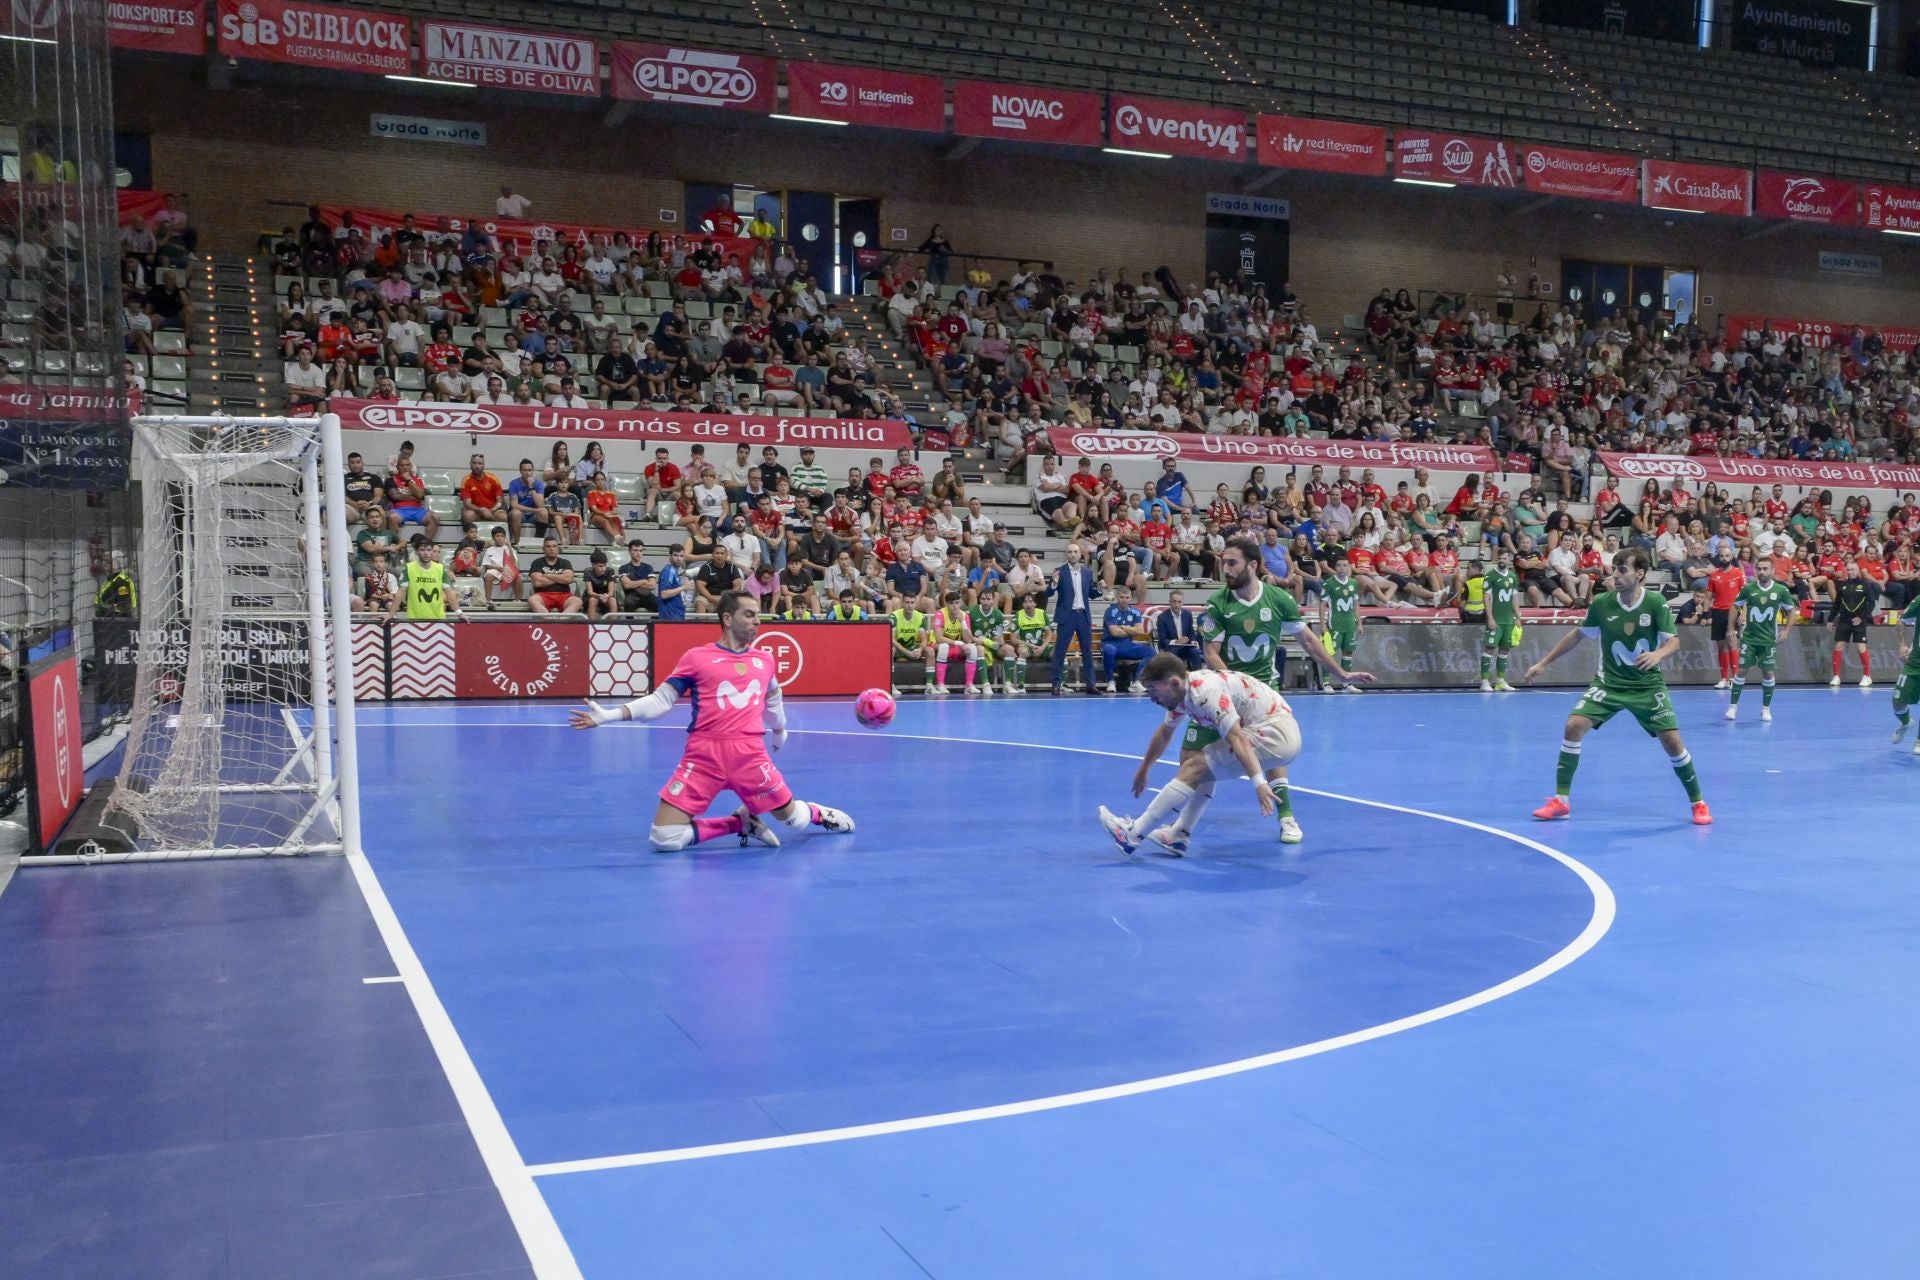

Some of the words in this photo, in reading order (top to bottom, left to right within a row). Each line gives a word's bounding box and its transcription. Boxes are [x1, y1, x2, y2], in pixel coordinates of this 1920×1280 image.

[282, 8, 407, 50] SEIBLOCK
[1743, 3, 1852, 35] Ayuntamiento
[440, 28, 581, 72] MANZANO
[1757, 34, 1777, 53] de
[1781, 38, 1835, 62] Murcia
[426, 62, 506, 84] ACEITES
[511, 71, 536, 86] DE
[541, 74, 595, 92] OLIVA
[858, 88, 914, 105] karkemis
[992, 95, 1063, 120] NOVAC
[376, 120, 428, 135] Grada
[1283, 133, 1303, 152] itv
[1306, 139, 1324, 149] red
[1326, 139, 1374, 154] itevemur
[1443, 150, 1473, 166] SALUD
[1546, 158, 1584, 172] Aditivos
[1586, 162, 1600, 173] del
[1602, 163, 1635, 177] Sureste
[1674, 177, 1742, 200] CaixaBank
[1210, 197, 1248, 211] Grada
[1254, 201, 1286, 214] Norte
[1885, 214, 1898, 226] de
[533, 416, 604, 436] Uno
[618, 417, 681, 435] más
[693, 419, 729, 435] de
[741, 420, 765, 437] la
[776, 420, 884, 442] familia
[1202, 436, 1258, 454] Uno
[1268, 442, 1318, 457] más
[1326, 444, 1354, 459] de
[1361, 445, 1382, 460] la
[1391, 443, 1476, 465] familia
[1720, 459, 1766, 476] Uno
[1775, 462, 1813, 478] más
[1819, 464, 1843, 480] de
[1847, 465, 1866, 480] la
[249, 629, 288, 645] SALA
[485, 655, 520, 695] SUELA
[1582, 686, 1607, 703] 20
